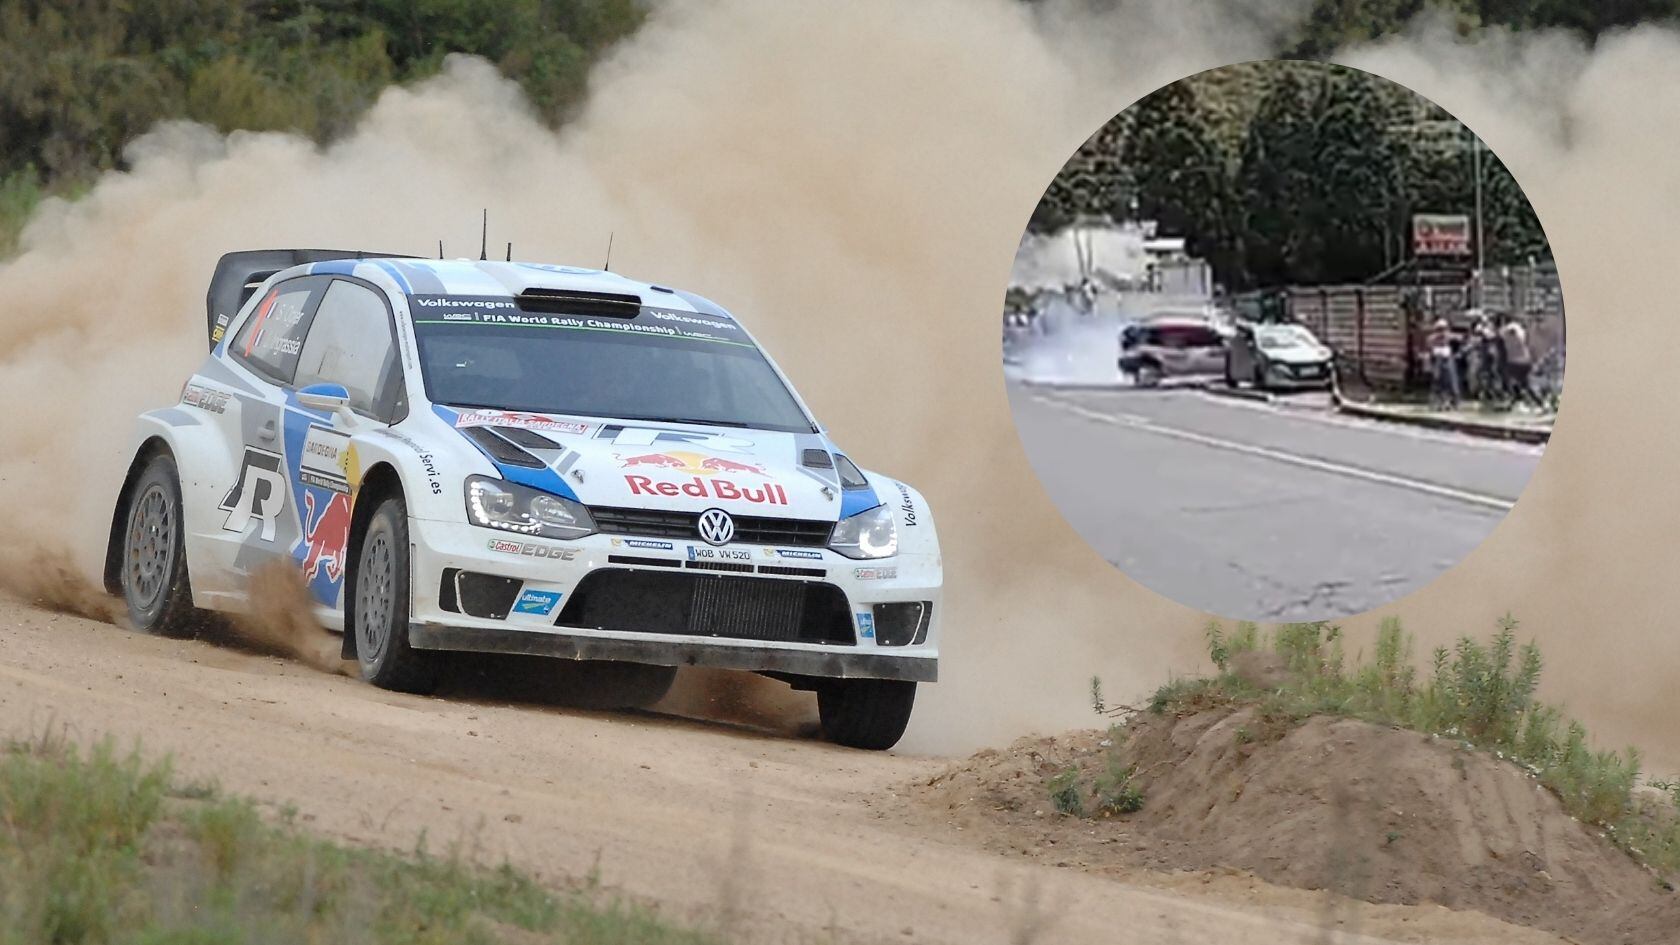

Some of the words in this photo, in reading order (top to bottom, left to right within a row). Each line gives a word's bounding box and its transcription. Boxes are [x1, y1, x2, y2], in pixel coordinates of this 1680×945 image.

[417, 299, 515, 309] Volkswagen
[483, 314, 507, 322] FIA
[508, 315, 548, 325] World
[551, 317, 584, 327] Rally
[587, 319, 675, 335] Championship
[650, 311, 737, 330] Volkswagen
[461, 412, 491, 424] RALLY
[420, 454, 442, 495] Servies
[624, 475, 709, 497] Red
[710, 479, 788, 505] Bull
[496, 541, 520, 552] Castrol
[521, 543, 579, 561] EDGE
[629, 541, 672, 549] MICHELIN
[695, 549, 715, 558] WOB
[718, 550, 731, 559] VW
[732, 551, 751, 560] 520
[781, 551, 822, 559] MICHELIN
